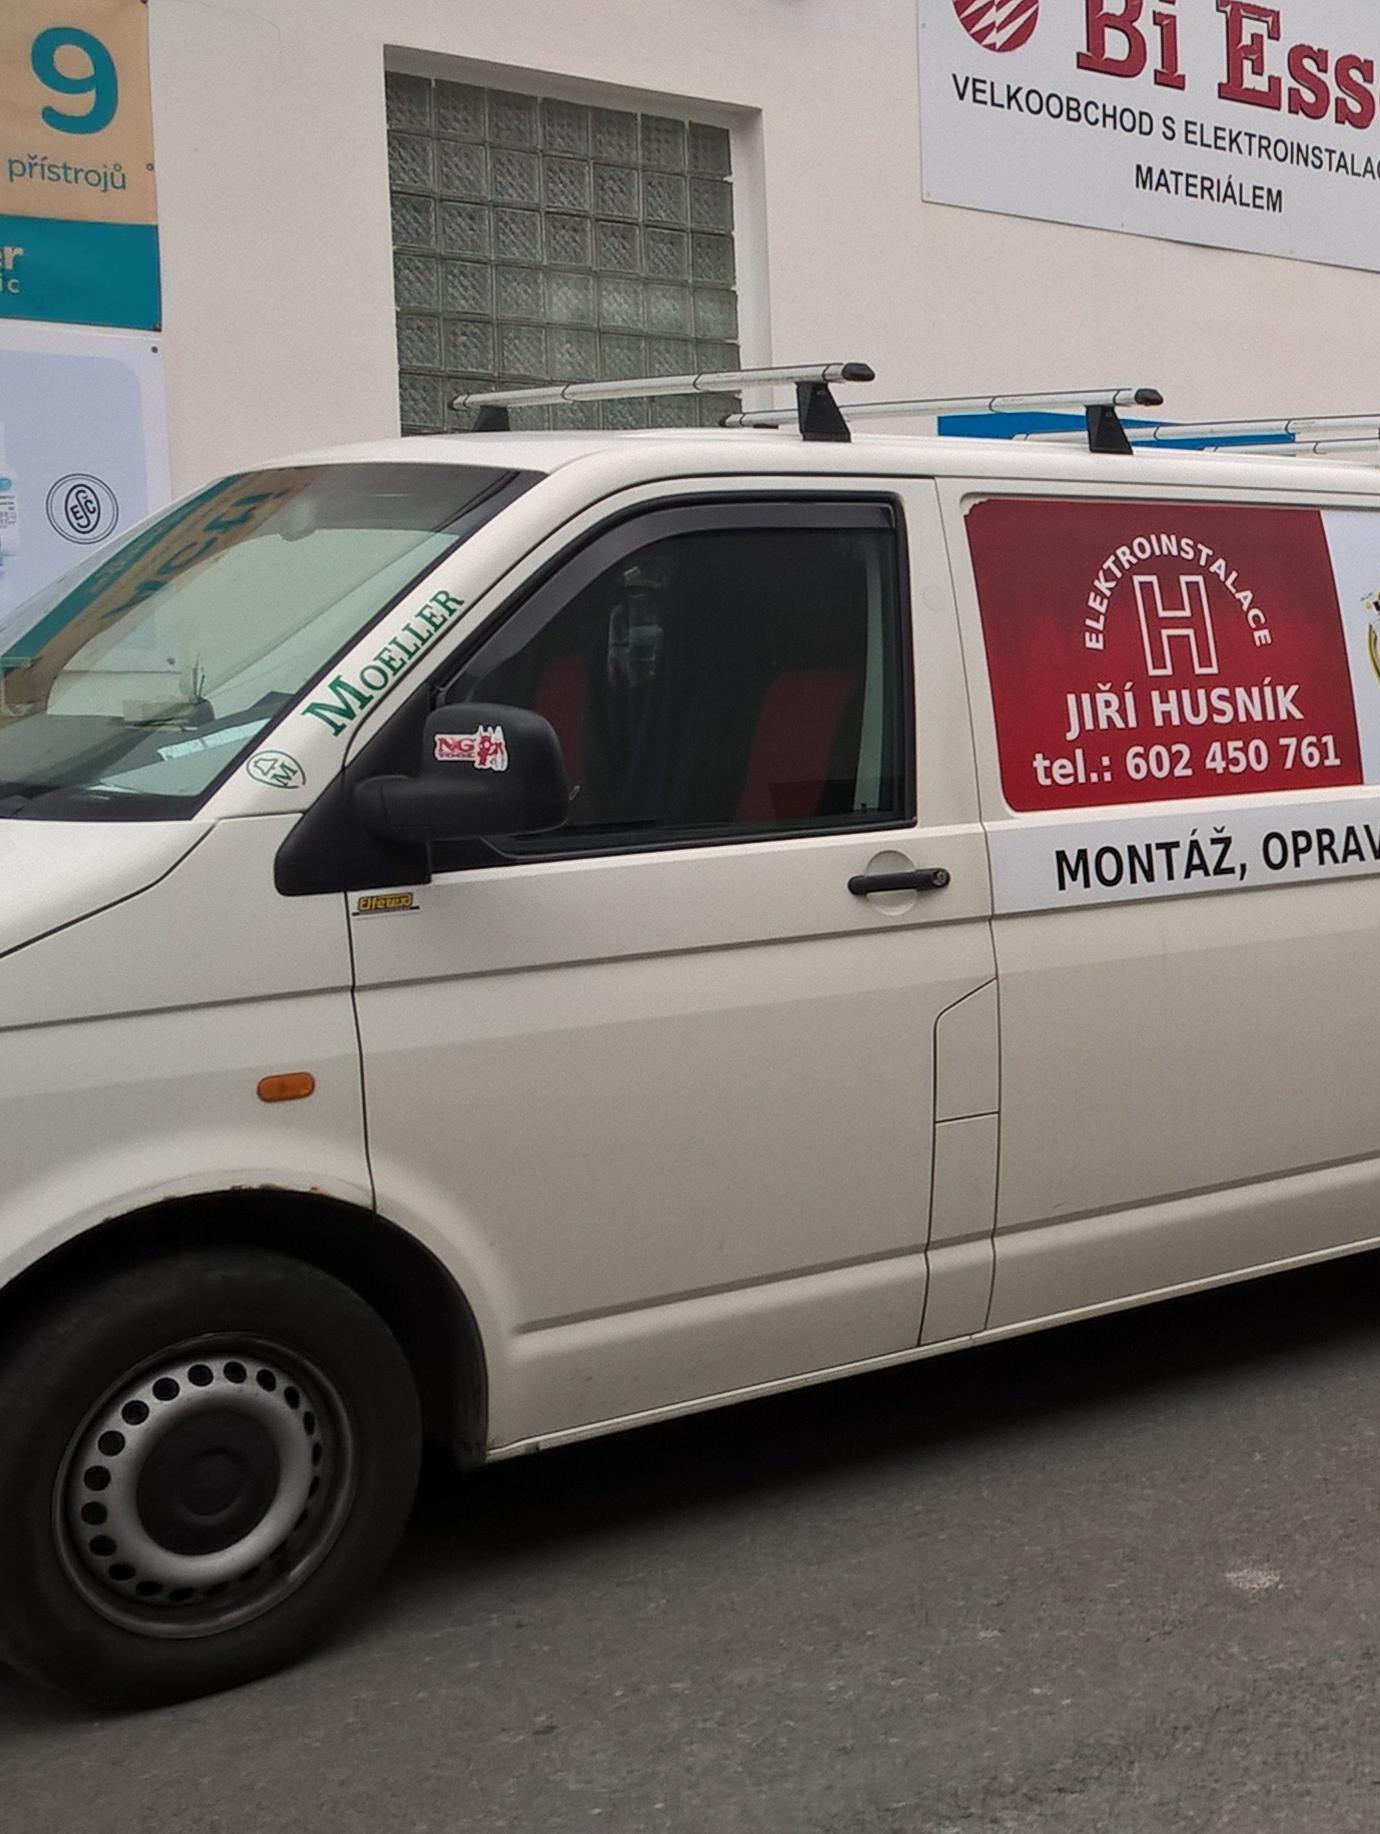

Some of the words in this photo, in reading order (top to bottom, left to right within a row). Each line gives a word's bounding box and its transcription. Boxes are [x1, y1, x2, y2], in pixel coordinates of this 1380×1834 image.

[1076, 0, 1186, 91] Bi
[30, 26, 119, 135] 9
[951, 73, 1154, 136] VELKOOBCHOD
[1161, 115, 1177, 141] S
[8, 154, 127, 193] přístrojů
[1135, 163, 1283, 214] MATERIÁLEM
[1085, 532, 1272, 651] ELEKTROINSTALACE
[1132, 574, 1219, 676] H
[1065, 681, 1138, 742] JIŘÍ
[1151, 677, 1305, 728] HUSNÍK
[1032, 748, 1113, 787] tel.:
[1125, 743, 1194, 782] 602
[1205, 739, 1270, 775] 450
[1279, 734, 1342, 770] 761
[1055, 825, 1248, 892] MONTÁŽ,
